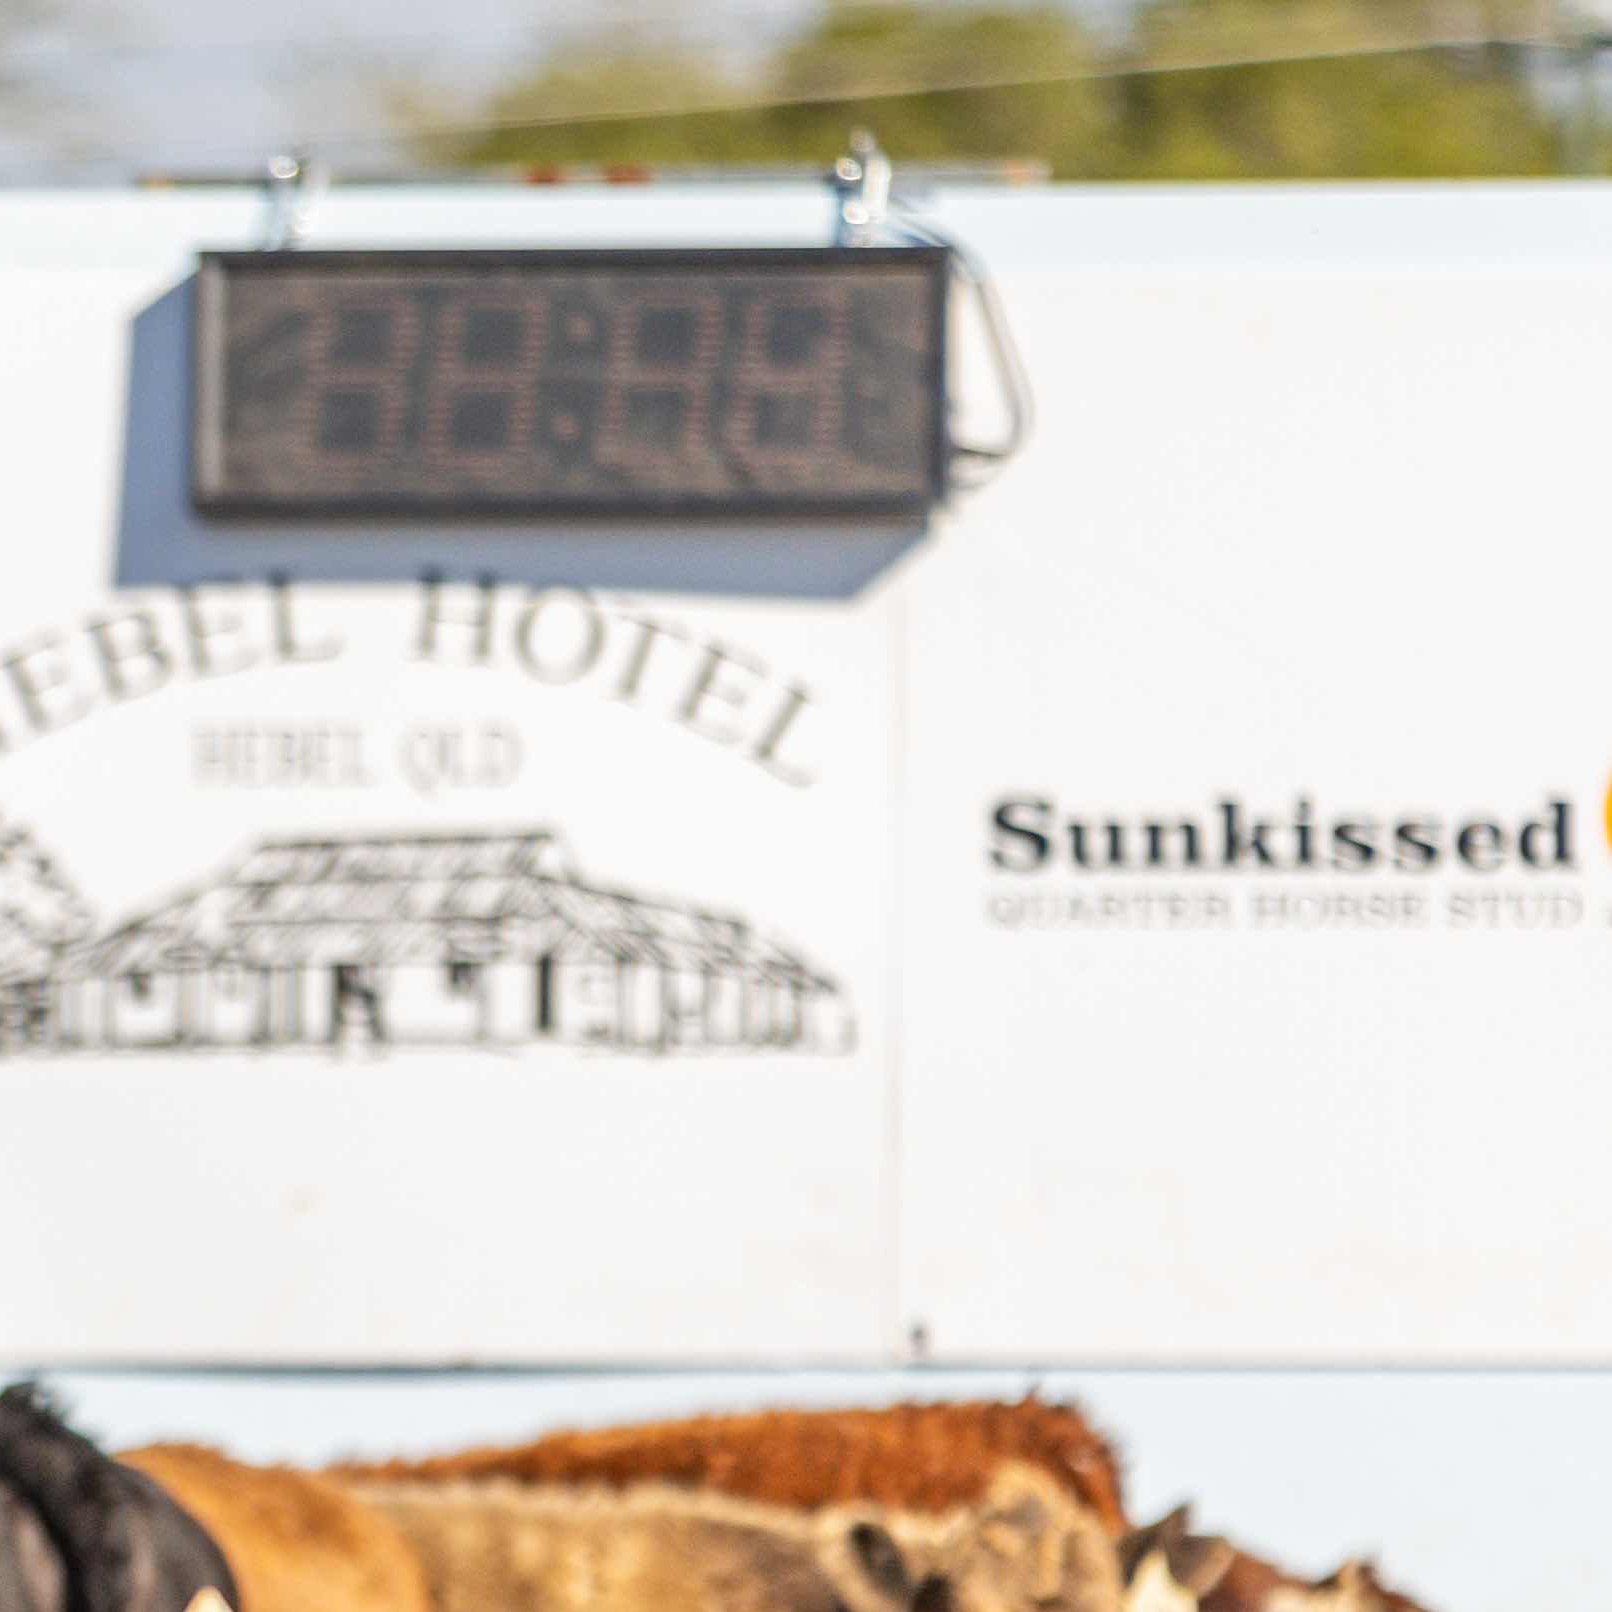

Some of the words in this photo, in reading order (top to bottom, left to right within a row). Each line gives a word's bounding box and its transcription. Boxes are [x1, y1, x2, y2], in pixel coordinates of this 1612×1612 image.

[407, 565, 818, 788] HOTEL
[192, 720, 369, 789] HEBEL
[397, 720, 524, 798] QLD
[989, 796, 1576, 871] Sunkissed
[984, 888, 1233, 930] QUARTER
[1251, 888, 1427, 926] HORSE
[1445, 888, 1584, 927] STUD
